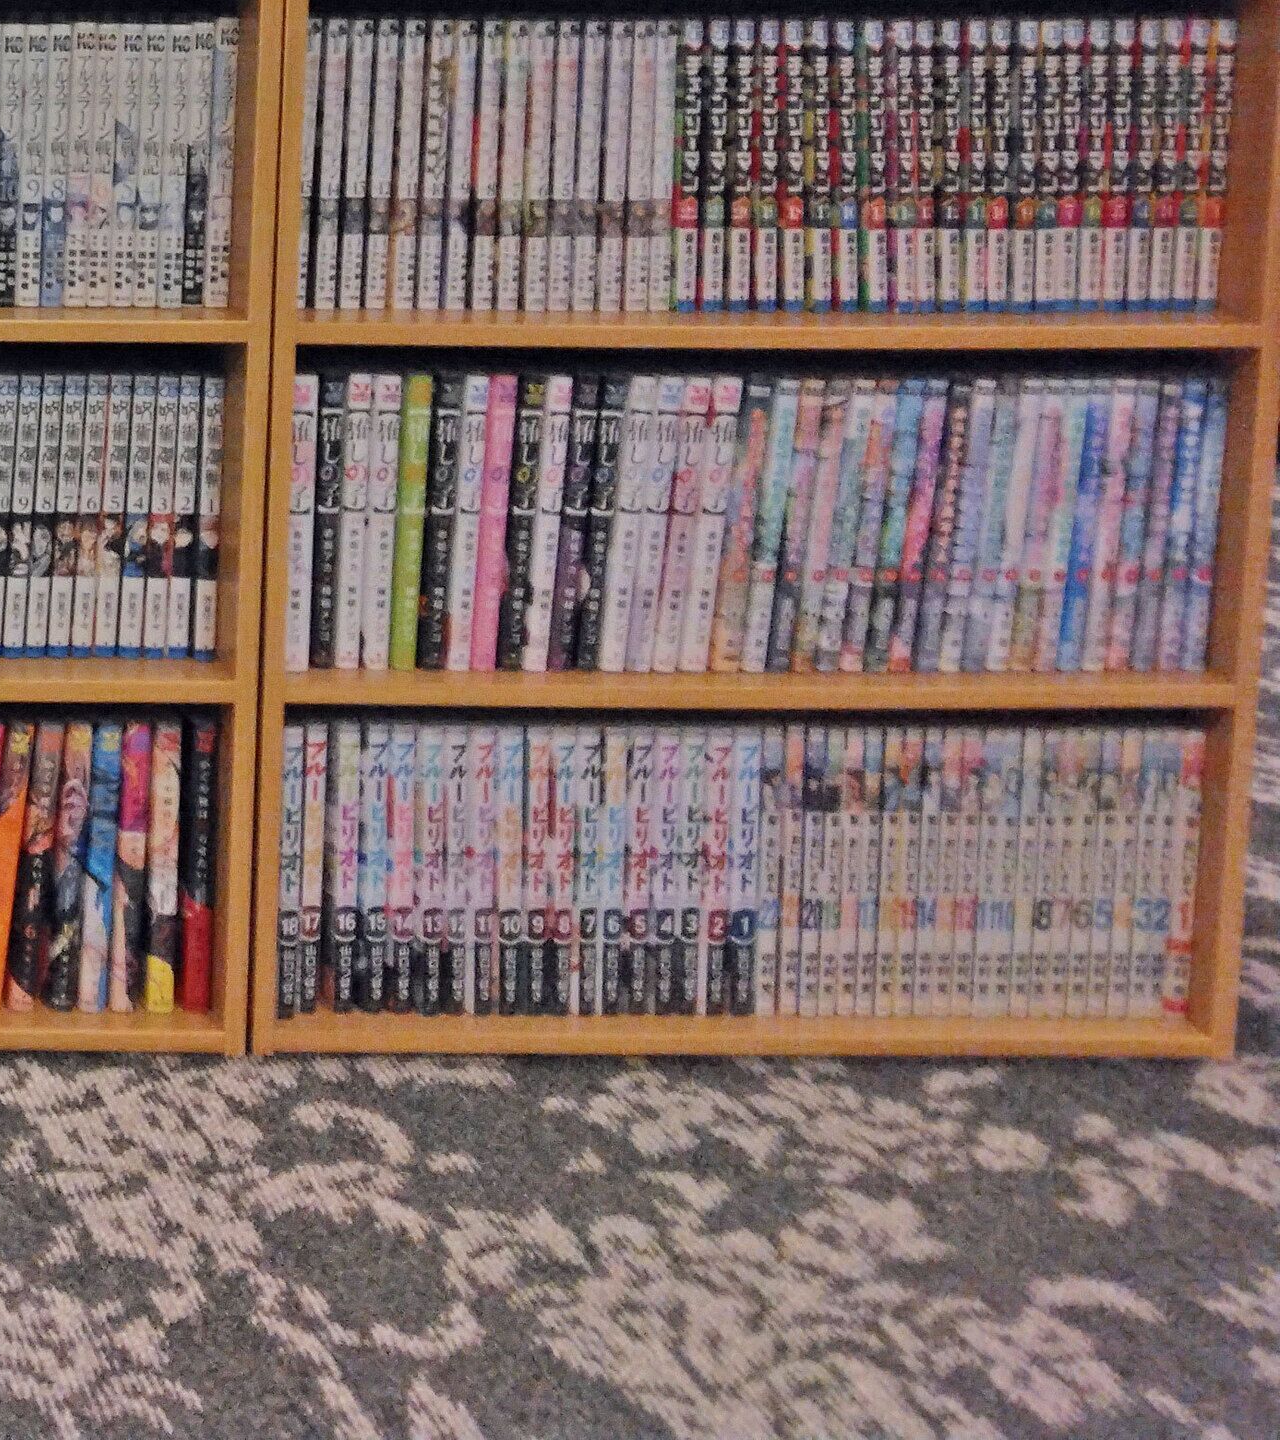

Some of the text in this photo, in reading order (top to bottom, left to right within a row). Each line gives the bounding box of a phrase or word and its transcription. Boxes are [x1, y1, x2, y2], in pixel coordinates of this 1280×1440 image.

[19, 497, 28, 510] 9
[87, 498, 96, 511] 6
[110, 497, 119, 510] 5
[181, 497, 190, 511] 2
